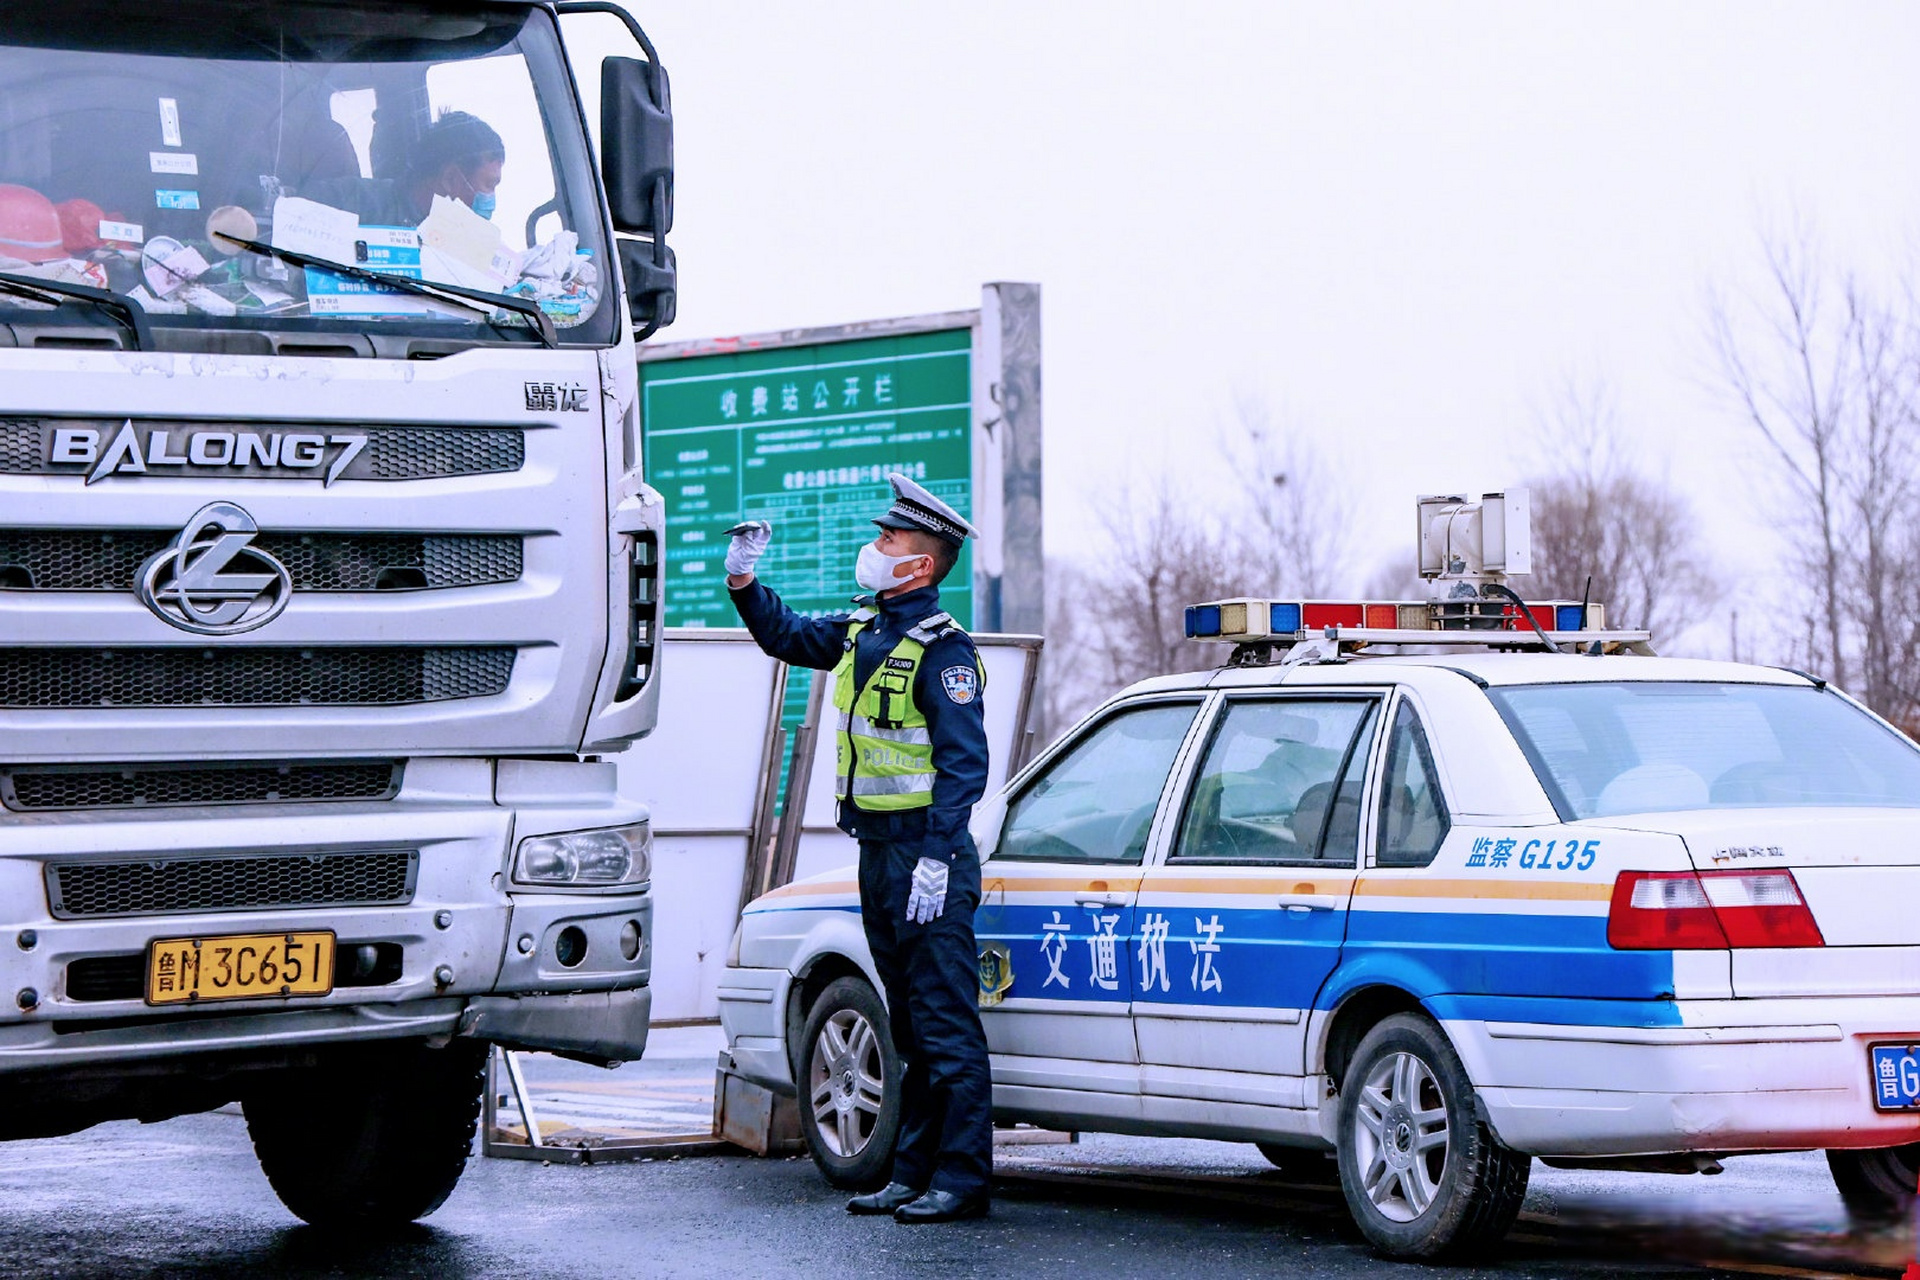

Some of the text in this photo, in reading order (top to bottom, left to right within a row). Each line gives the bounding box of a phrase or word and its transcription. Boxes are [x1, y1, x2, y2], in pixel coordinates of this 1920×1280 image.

[524, 381, 589, 411] 霸龙
[720, 373, 892, 418] 收费站公开栏
[50, 418, 367, 487] BALONG7
[863, 748, 926, 769] POLICE
[1465, 837, 1600, 871] 监察 G135
[158, 943, 320, 991] 鲁M3C651
[1040, 911, 1224, 993] 交通执法
[1879, 1056, 1920, 1098] 鲁G
